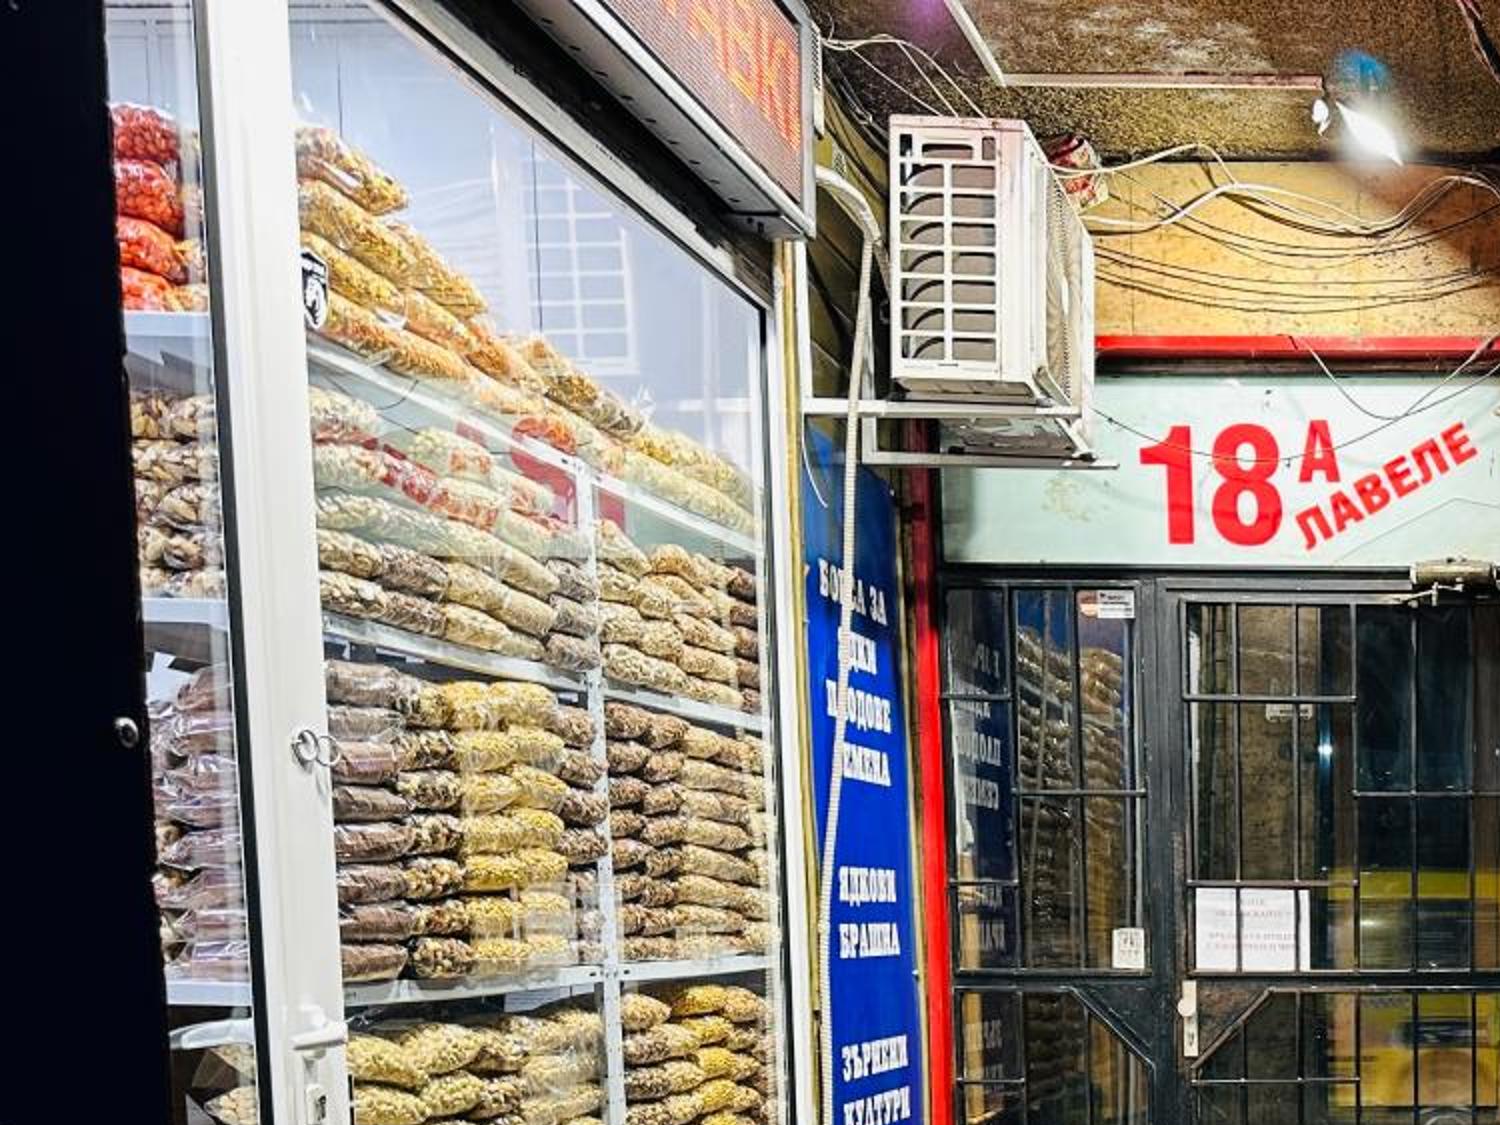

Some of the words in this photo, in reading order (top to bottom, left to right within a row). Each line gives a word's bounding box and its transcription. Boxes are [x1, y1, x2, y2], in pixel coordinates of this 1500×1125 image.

[1139, 423, 1282, 546] 18
[1298, 420, 1340, 482] А
[1295, 422, 1478, 550] ЛАВЕЛЕ
[869, 585, 888, 626] ЗА
[839, 866, 897, 907] ЯДКОВИ
[839, 922, 901, 959] БРАШНА
[841, 1033, 908, 1082] ЗЪРНЕНИ
